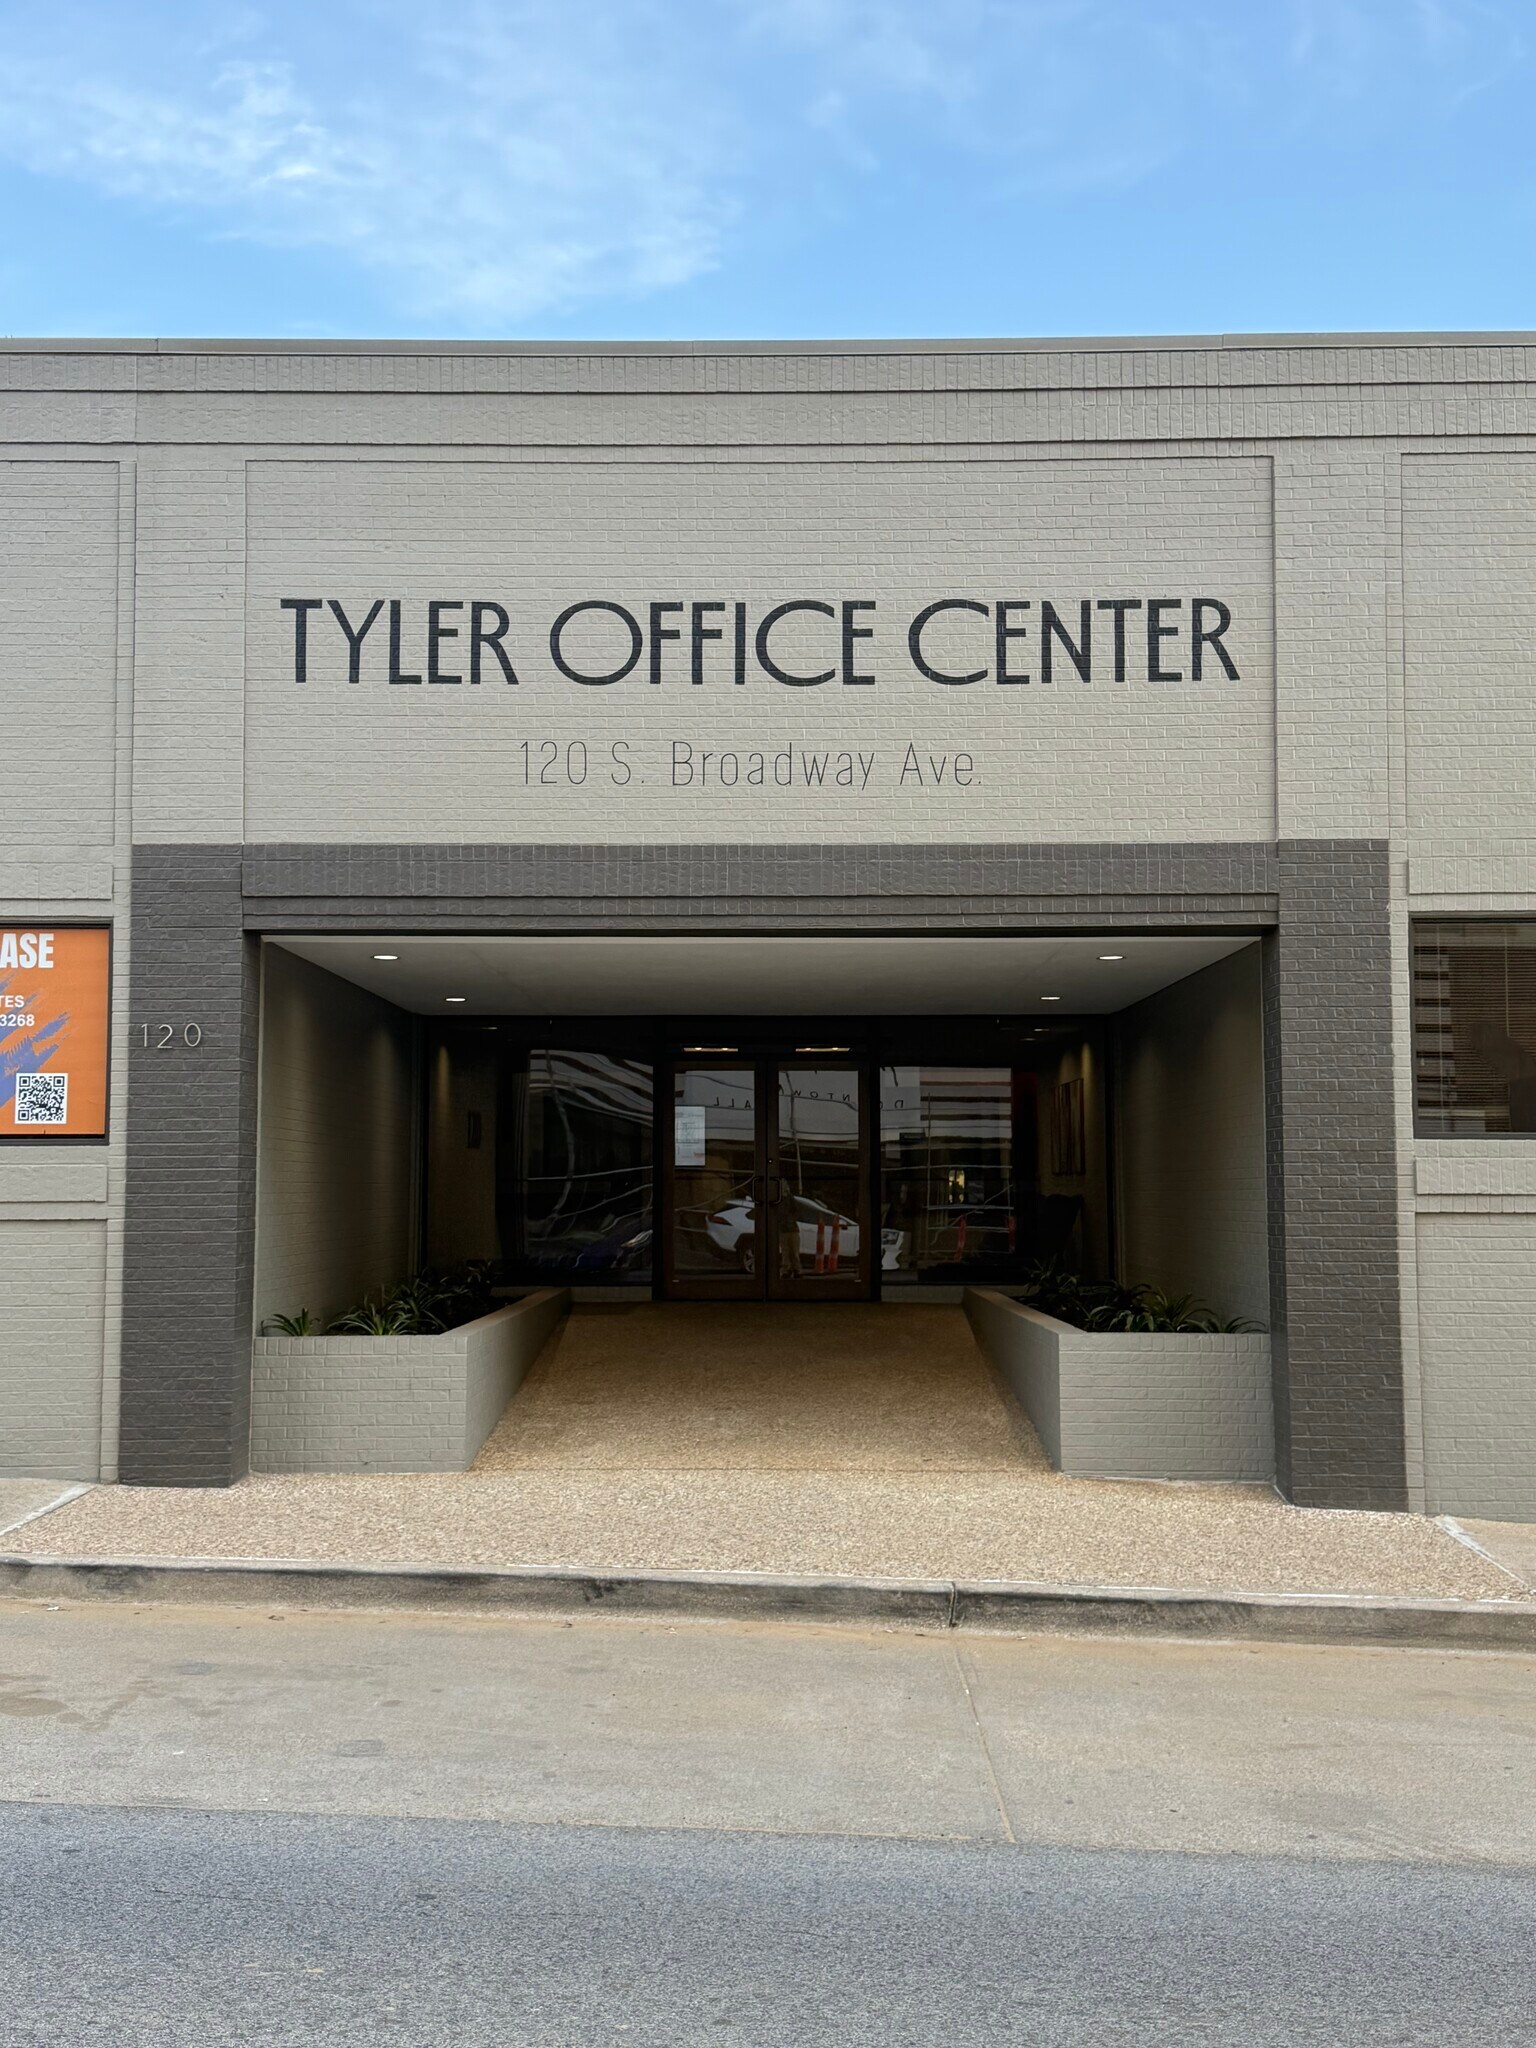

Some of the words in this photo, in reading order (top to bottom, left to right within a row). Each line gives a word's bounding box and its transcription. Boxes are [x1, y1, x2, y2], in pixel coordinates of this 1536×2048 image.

[279, 598, 519, 685] TYLER
[549, 600, 877, 687] OFFICE
[908, 598, 1241, 686] CENTER
[519, 740, 588, 785] 120
[610, 741, 646, 785] S.
[672, 740, 875, 791] Broadway
[899, 741, 982, 787] Ave.
[140, 1022, 202, 1049] 120
